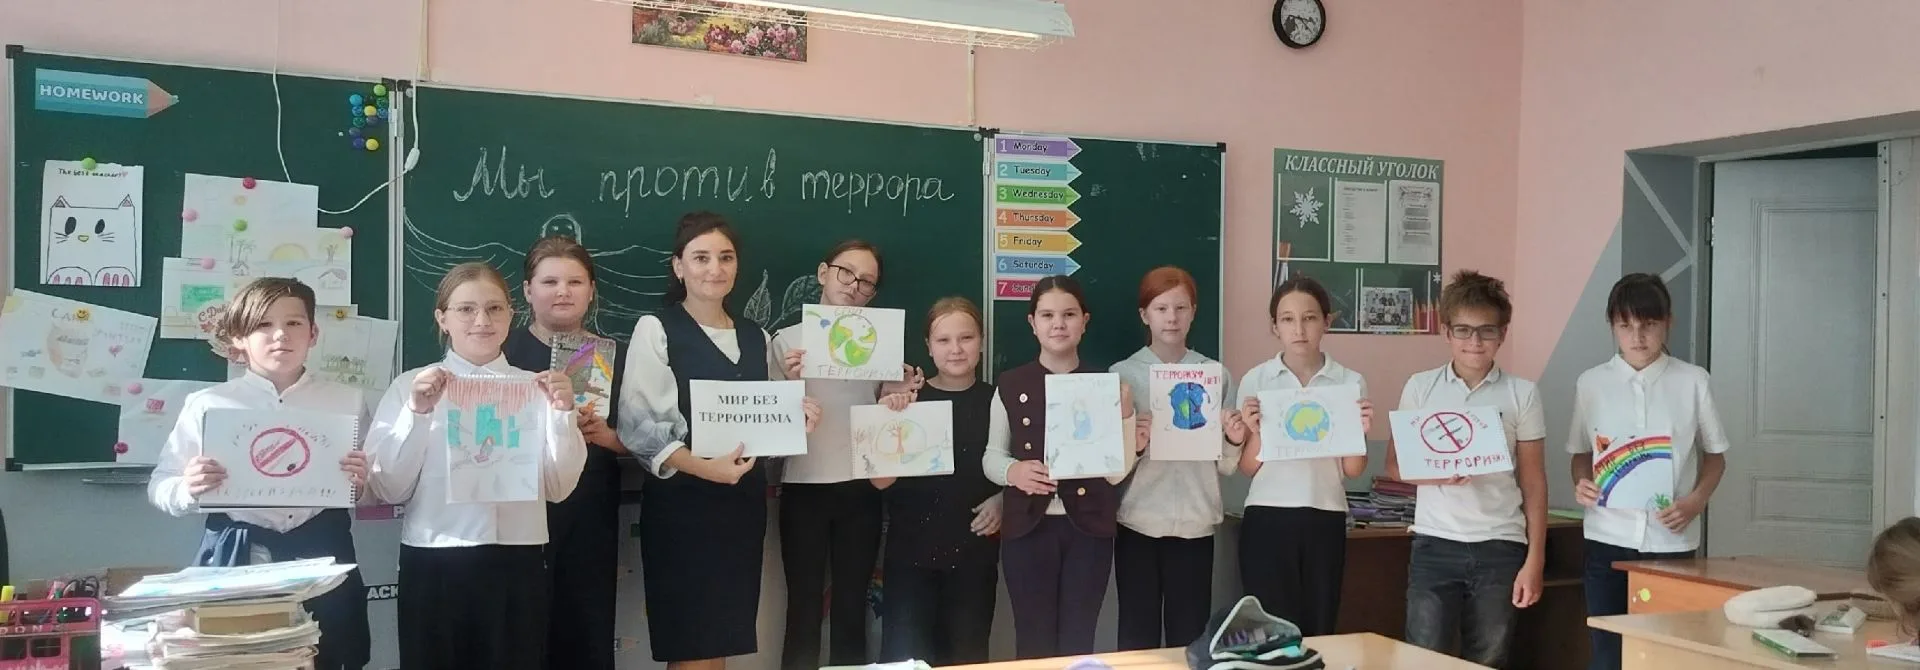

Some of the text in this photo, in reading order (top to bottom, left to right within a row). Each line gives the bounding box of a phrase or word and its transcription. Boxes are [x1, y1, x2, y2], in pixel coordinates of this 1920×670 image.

[39, 84, 144, 105] HOMEWORK
[1000, 140, 1048, 153] 1 Monday
[1000, 165, 1051, 177] 2 Tuesday
[1285, 154, 1439, 180] КЛАССНЫЙ УГОЛОК
[453, 146, 555, 200] Мы
[801, 170, 954, 216] террора
[999, 188, 1064, 201] 3 Wednesday
[998, 211, 1054, 223] 4 Thursday
[1000, 234, 1042, 247] 5 Friday
[999, 258, 1054, 271] 6 Saturday
[998, 282, 1008, 295] 7
[718, 395, 778, 406] МИР БЕЗ
[699, 411, 792, 424] ТЕРРОРИЗМА
